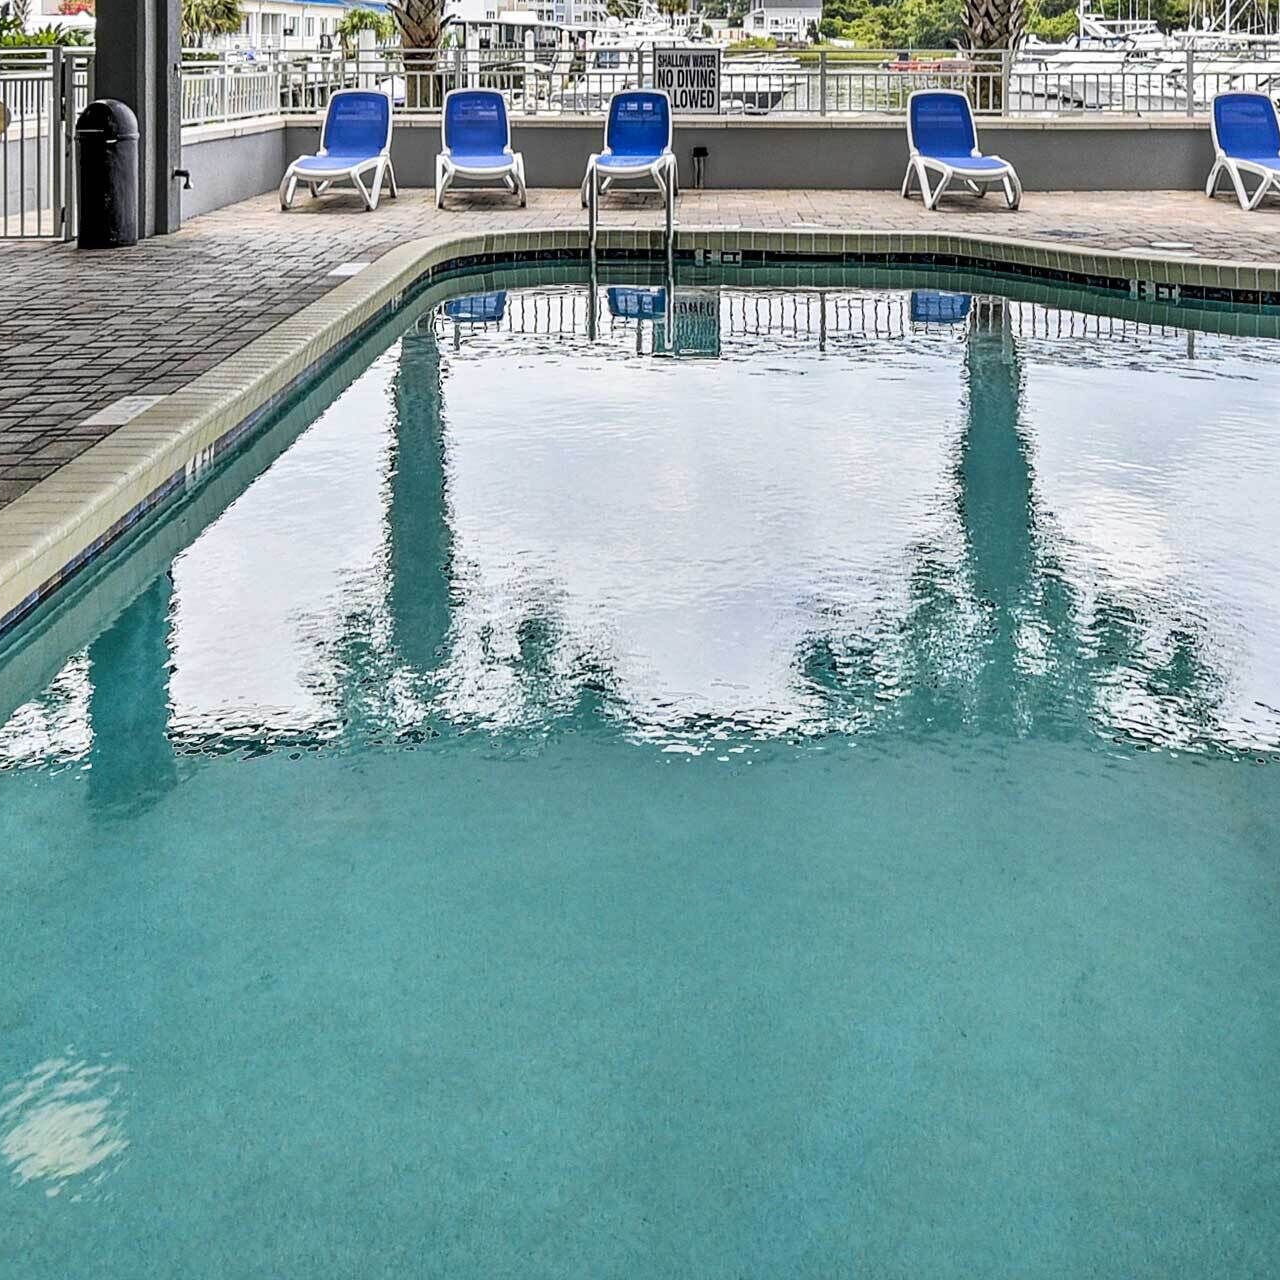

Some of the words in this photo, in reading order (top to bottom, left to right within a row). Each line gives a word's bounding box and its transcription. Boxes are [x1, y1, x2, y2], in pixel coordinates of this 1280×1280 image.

[657, 54, 691, 68] SHALLOW
[692, 54, 716, 68] WATER
[658, 69, 674, 88] NO
[677, 69, 716, 88] DIVING
[667, 89, 715, 109] LOWED
